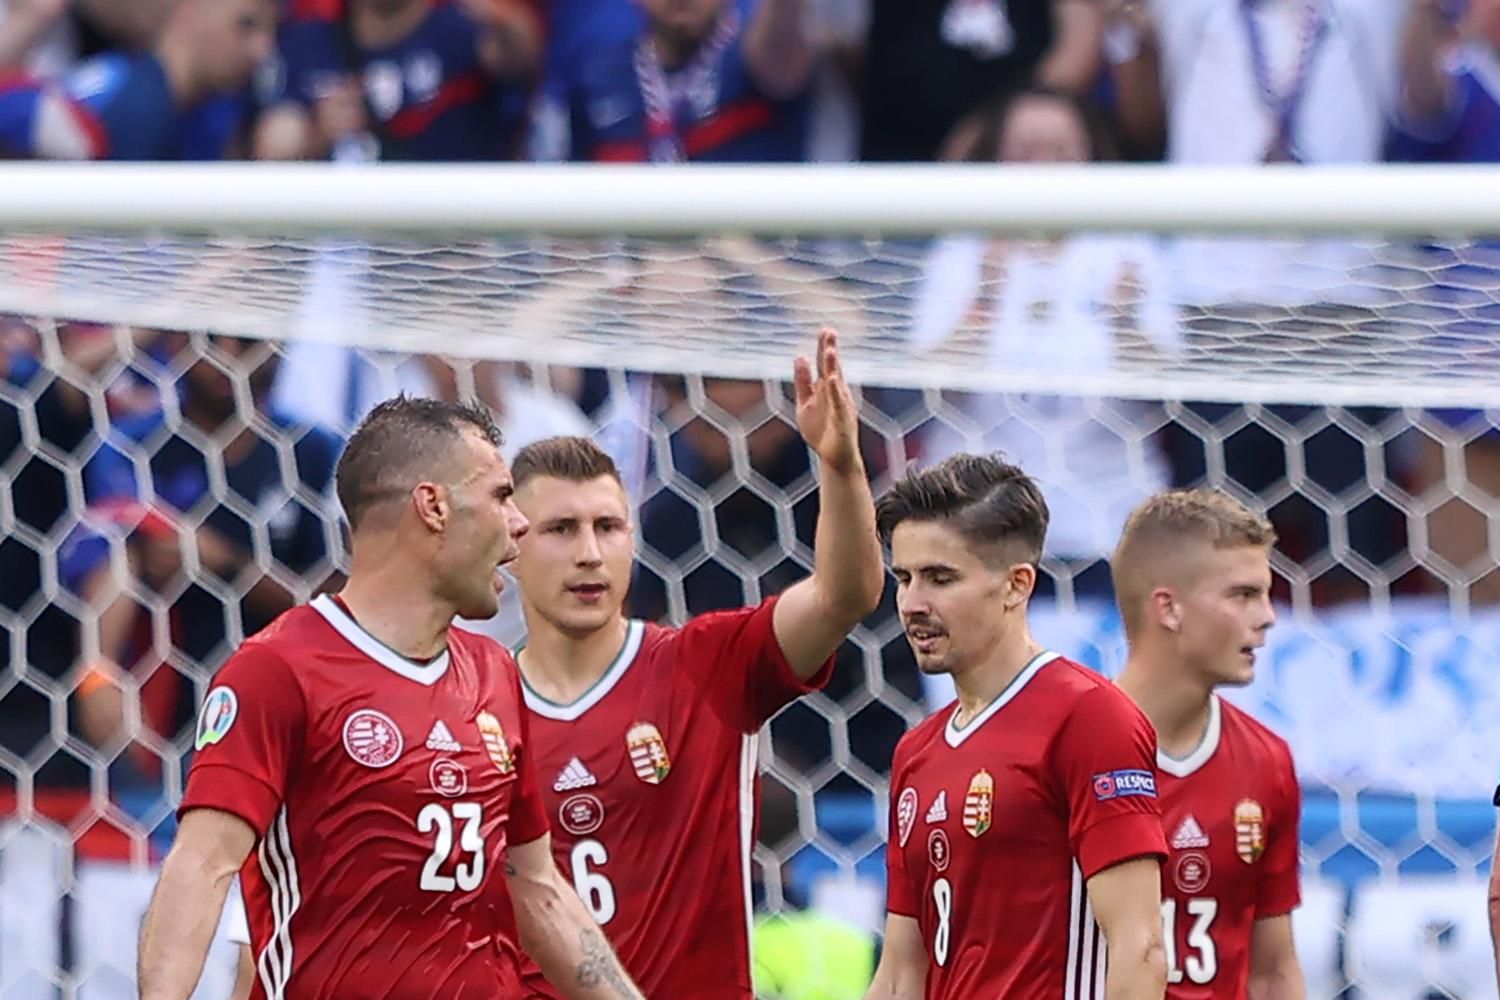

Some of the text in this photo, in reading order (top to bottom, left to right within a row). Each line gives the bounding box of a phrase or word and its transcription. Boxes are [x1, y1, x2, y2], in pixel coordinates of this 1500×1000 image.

[417, 803, 485, 893] 23
[571, 839, 617, 926] 6
[933, 877, 952, 968] 8
[1160, 897, 1218, 985] 13
